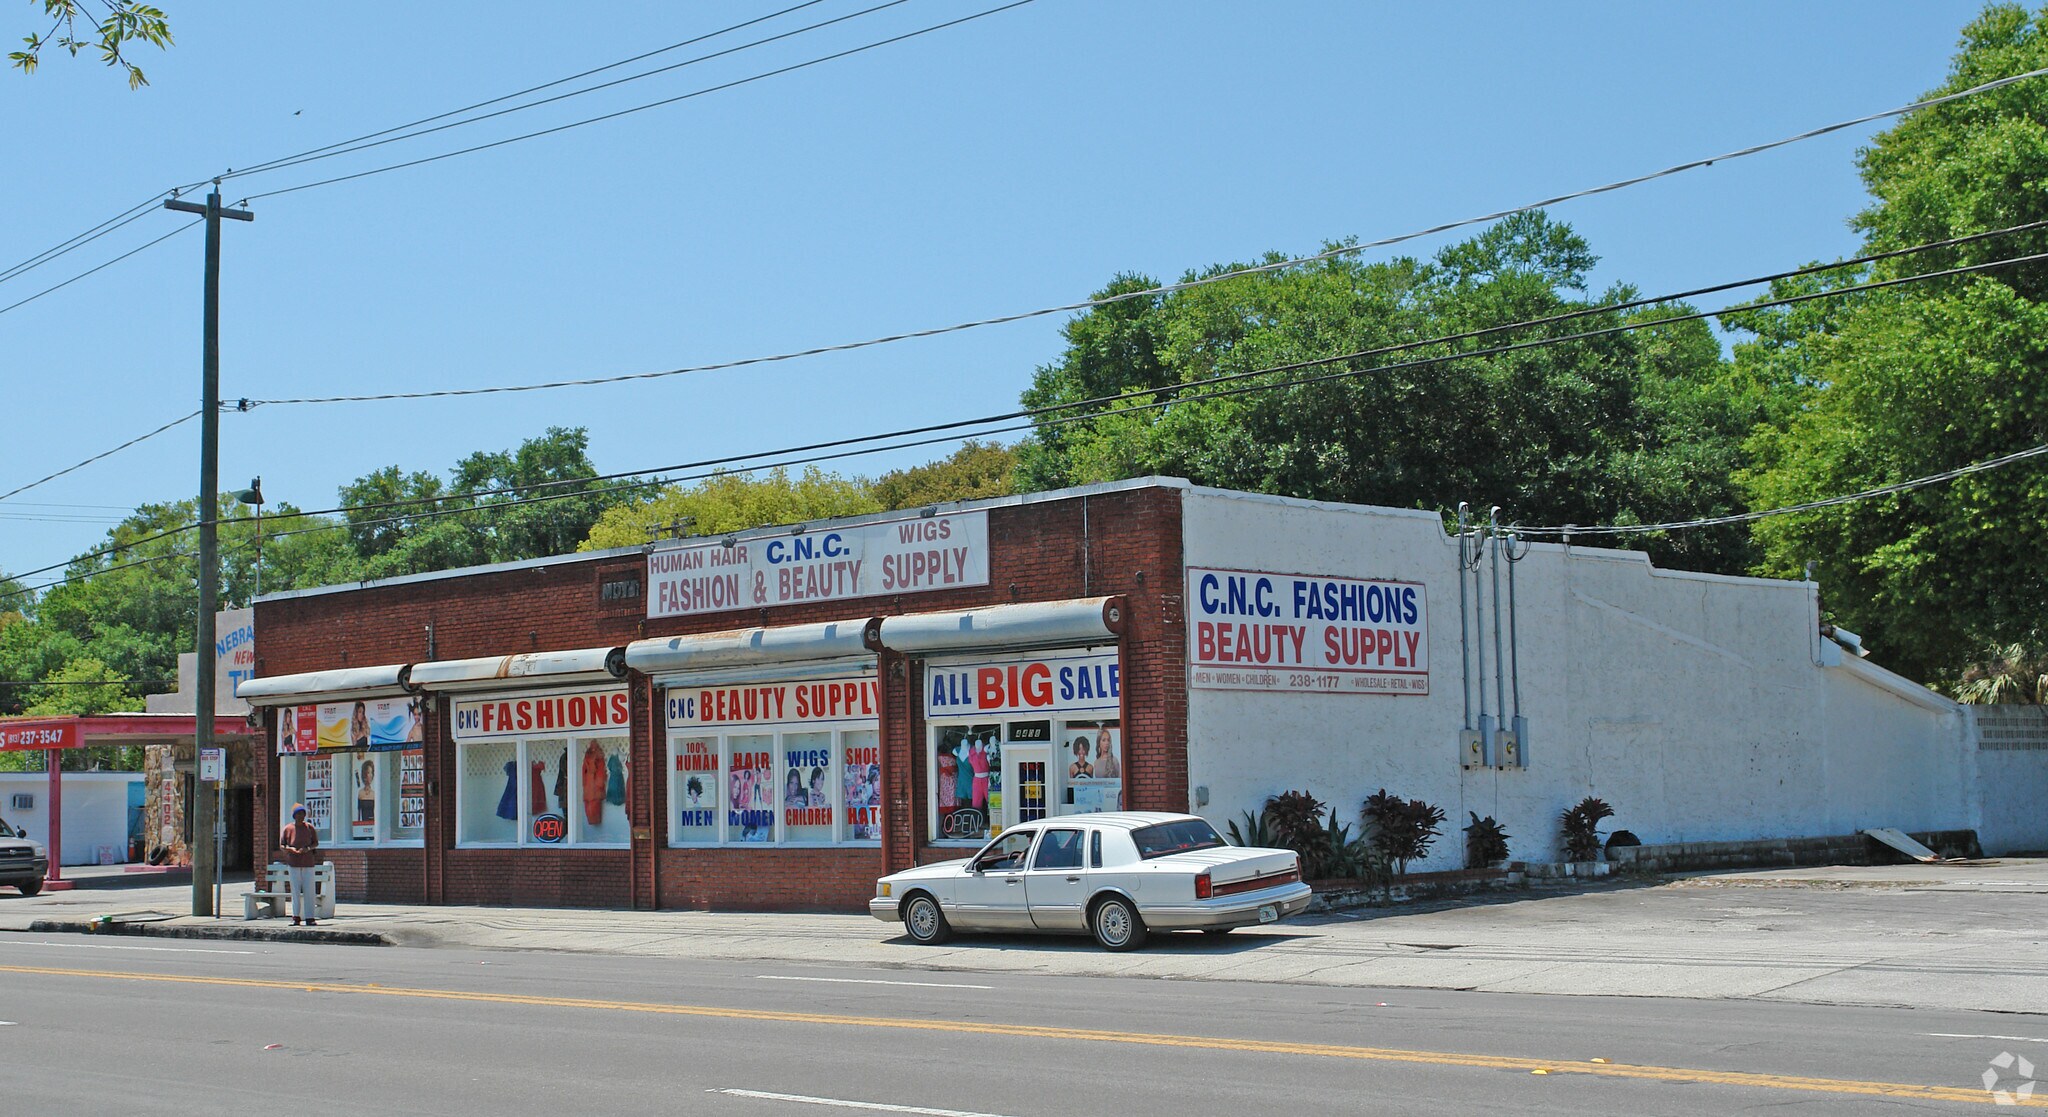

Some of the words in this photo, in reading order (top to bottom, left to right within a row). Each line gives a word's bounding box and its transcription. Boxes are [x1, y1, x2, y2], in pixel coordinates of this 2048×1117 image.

[898, 519, 951, 544] WIGS
[767, 533, 850, 564] C.N.C.
[650, 550, 703, 574] HUMAN
[711, 545, 748, 567] HAIR
[659, 573, 739, 613] FASHION
[753, 570, 767, 604] &
[779, 559, 862, 601] BEAUTY
[882, 547, 968, 590] SUPPLY
[1200, 573, 1281, 618] C.N.C.
[1293, 580, 1418, 625] FASHIONS
[1197, 621, 1306, 664] BEAUTY
[1324, 625, 1420, 668] SUPPLY
[932, 673, 972, 706] ALL
[977, 662, 1054, 710] BIG
[1059, 664, 1120, 700] SALE
[1195, 672, 1211, 684] MEN
[1215, 673, 1240, 685] WOMEN
[1245, 674, 1277, 686] CHILDREN
[1354, 677, 1387, 688] WHOLESALE
[1391, 678, 1408, 689] RETAIL
[458, 709, 479, 730] CNC
[482, 693, 629, 732] FASHIONS
[669, 697, 695, 720] CNC
[700, 687, 786, 722] BEAUTY
[20, 729, 63, 745] 237-3547
[686, 742, 708, 753] 100%
[846, 747, 880, 765] SHOE
[676, 754, 718, 771] HUMAN
[733, 752, 770, 770] HAIR
[787, 749, 829, 767] WIGS
[163, 781, 172, 825] 4402
[682, 810, 713, 826] MEN
[728, 809, 775, 826] WOMEN
[785, 807, 832, 826] CHILDREN
[848, 807, 881, 825] HAT
[943, 812, 981, 834] OPEN
[534, 820, 563, 838] OPEN
